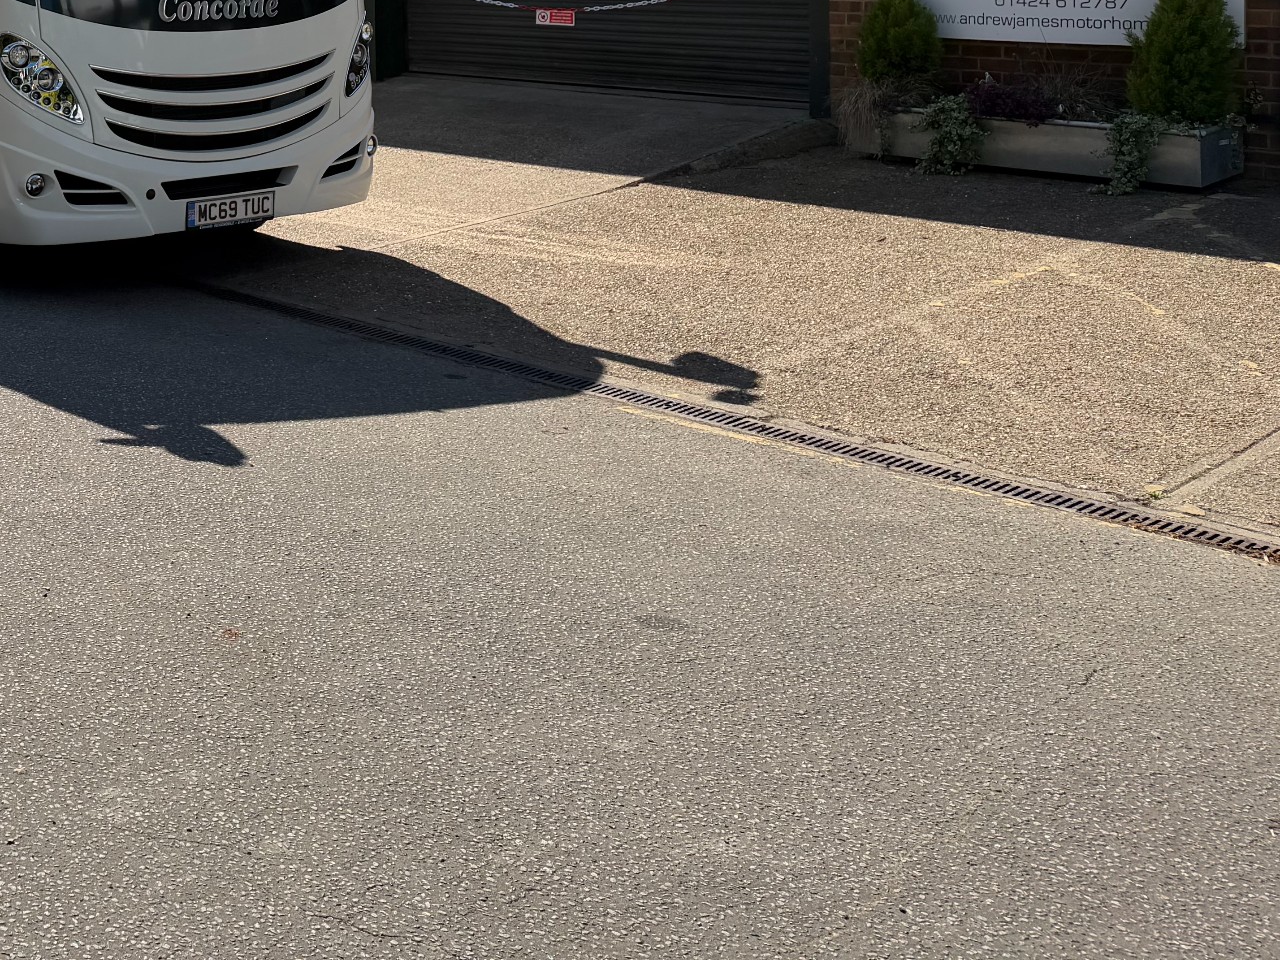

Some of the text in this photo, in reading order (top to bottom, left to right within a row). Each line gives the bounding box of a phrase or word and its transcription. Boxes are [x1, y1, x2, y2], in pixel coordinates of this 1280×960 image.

[934, 12, 1149, 31] ww.andrewjamesmotorhom
[198, 200, 238, 222] MC69
[242, 196, 270, 216] TUC
